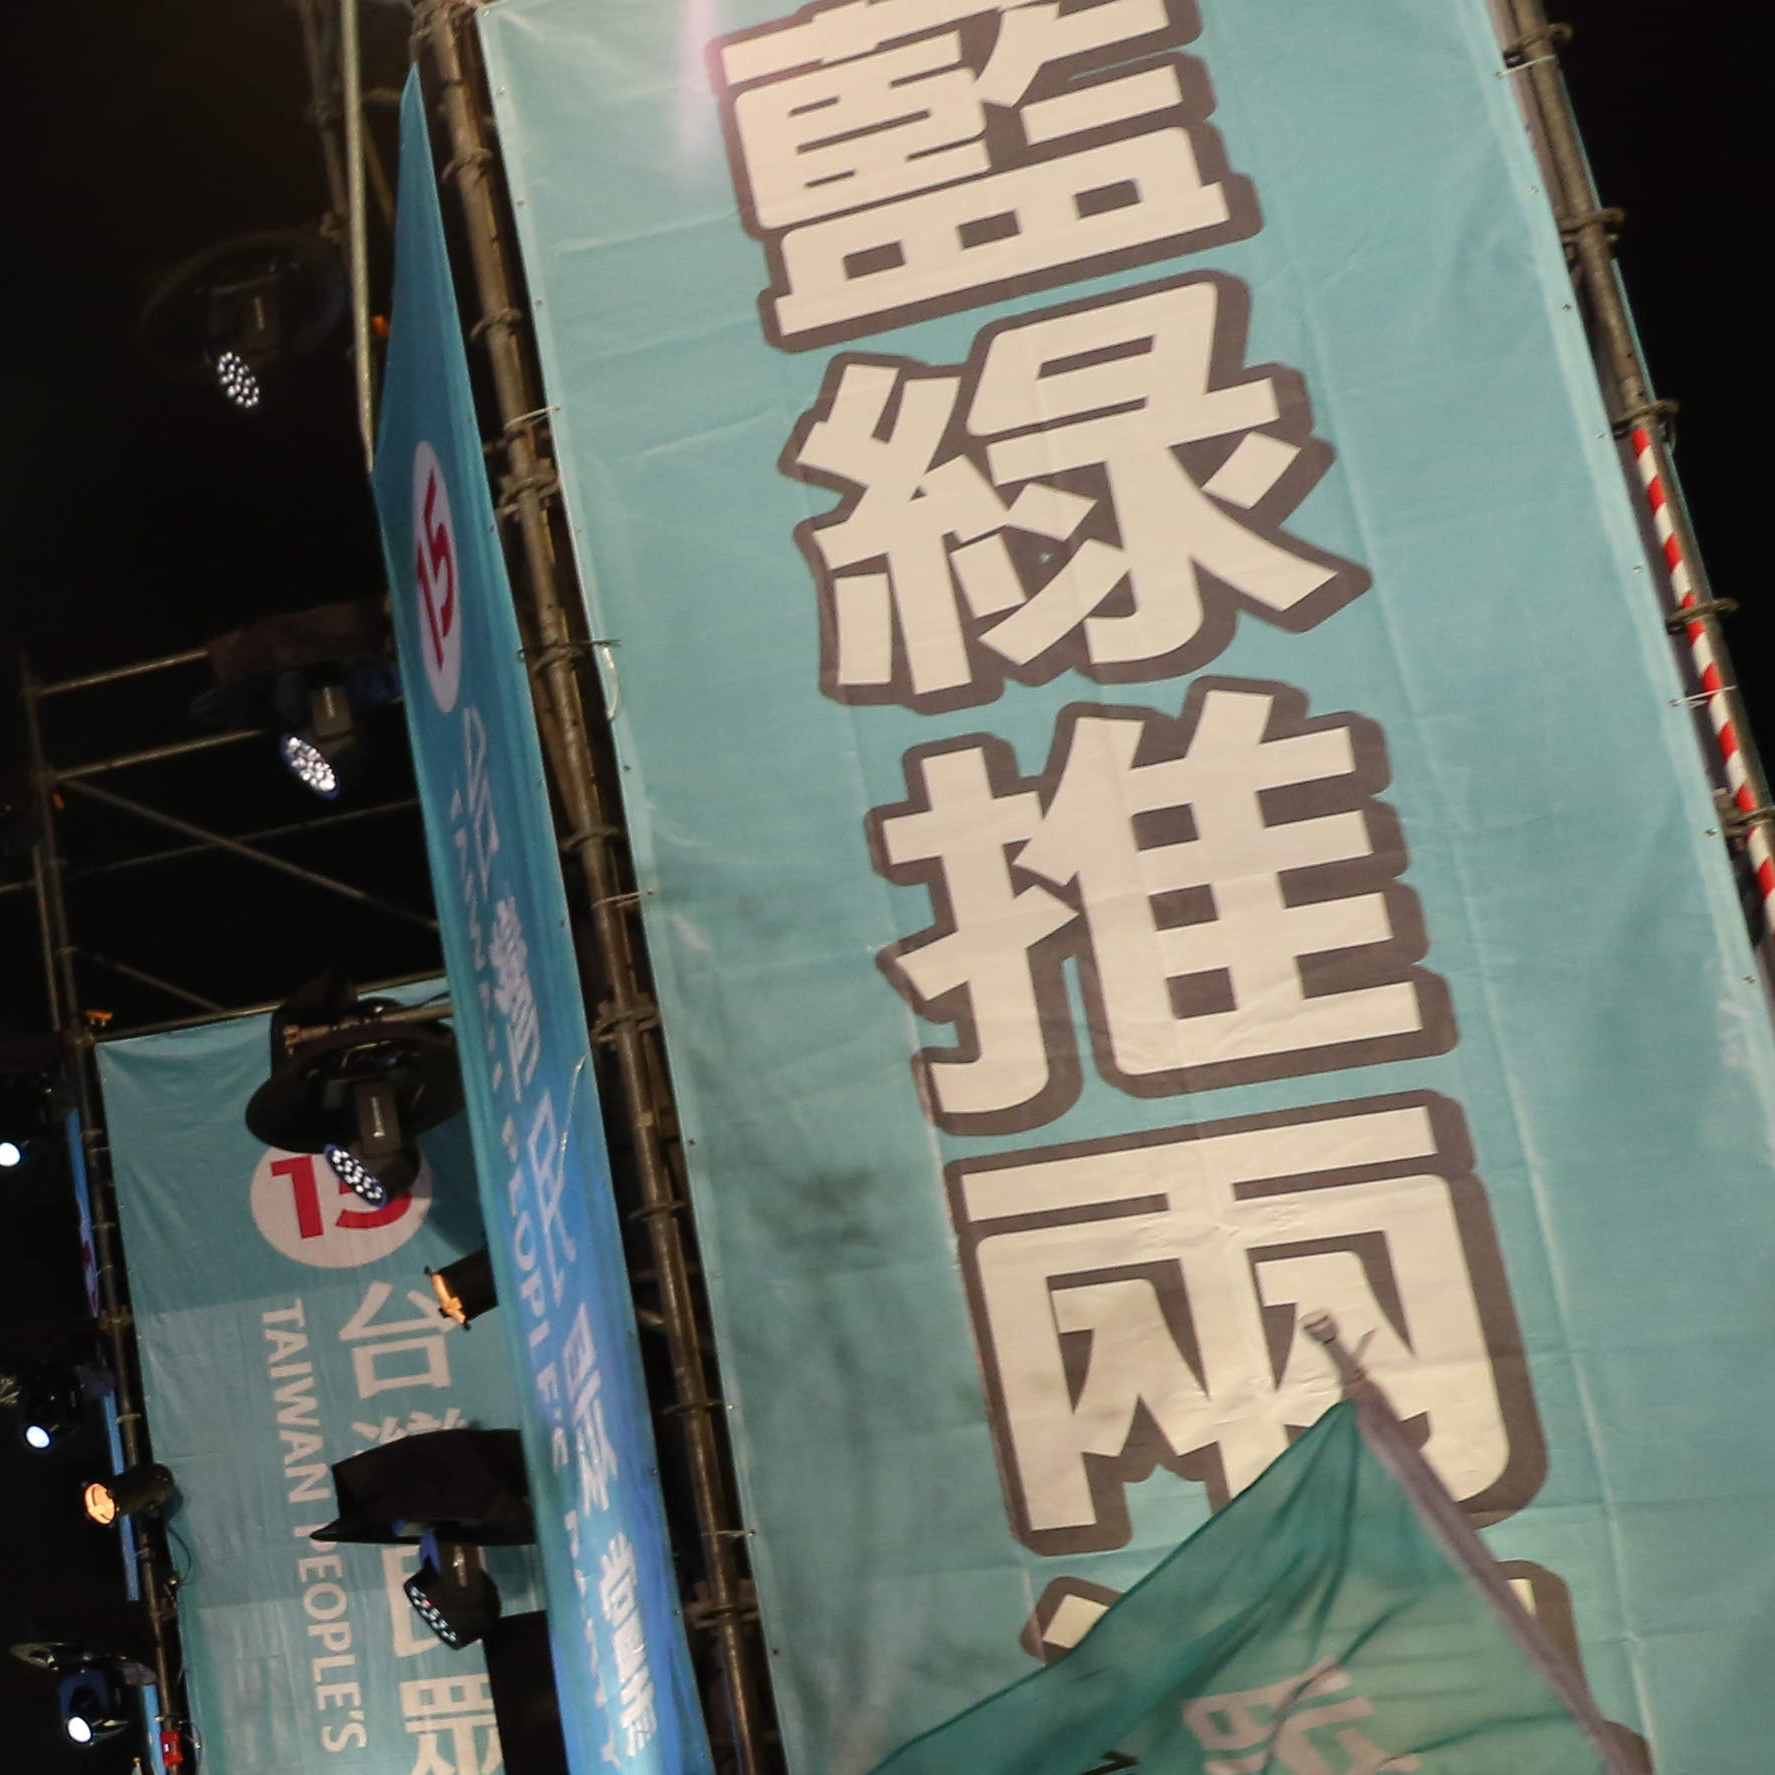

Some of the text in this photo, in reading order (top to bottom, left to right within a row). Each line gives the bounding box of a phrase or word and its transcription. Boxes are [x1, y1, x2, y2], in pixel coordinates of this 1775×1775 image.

[416, 470, 455, 673] 15
[258, 1300, 331, 1522] TAIWAN
[293, 1524, 368, 1754] PEOPLE'S
